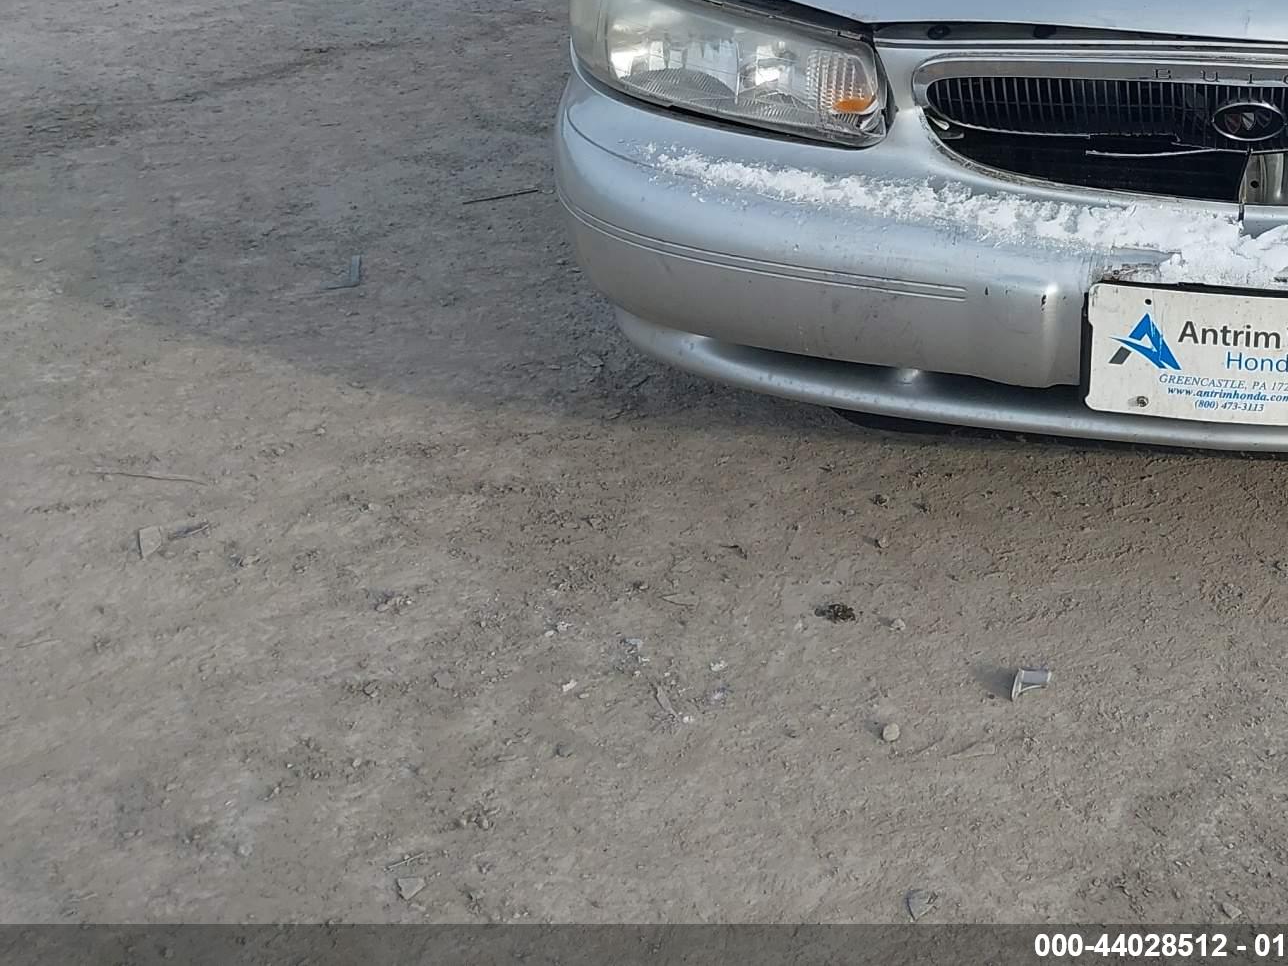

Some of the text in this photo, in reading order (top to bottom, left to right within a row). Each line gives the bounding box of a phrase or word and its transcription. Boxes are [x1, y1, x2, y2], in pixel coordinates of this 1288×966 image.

[1177, 320, 1281, 350] Antrim
[1159, 374, 1248, 391] GREENCASTLE,
[1252, 380, 1268, 391] PA
[1194, 400, 1265, 412] (800) 473-3113
